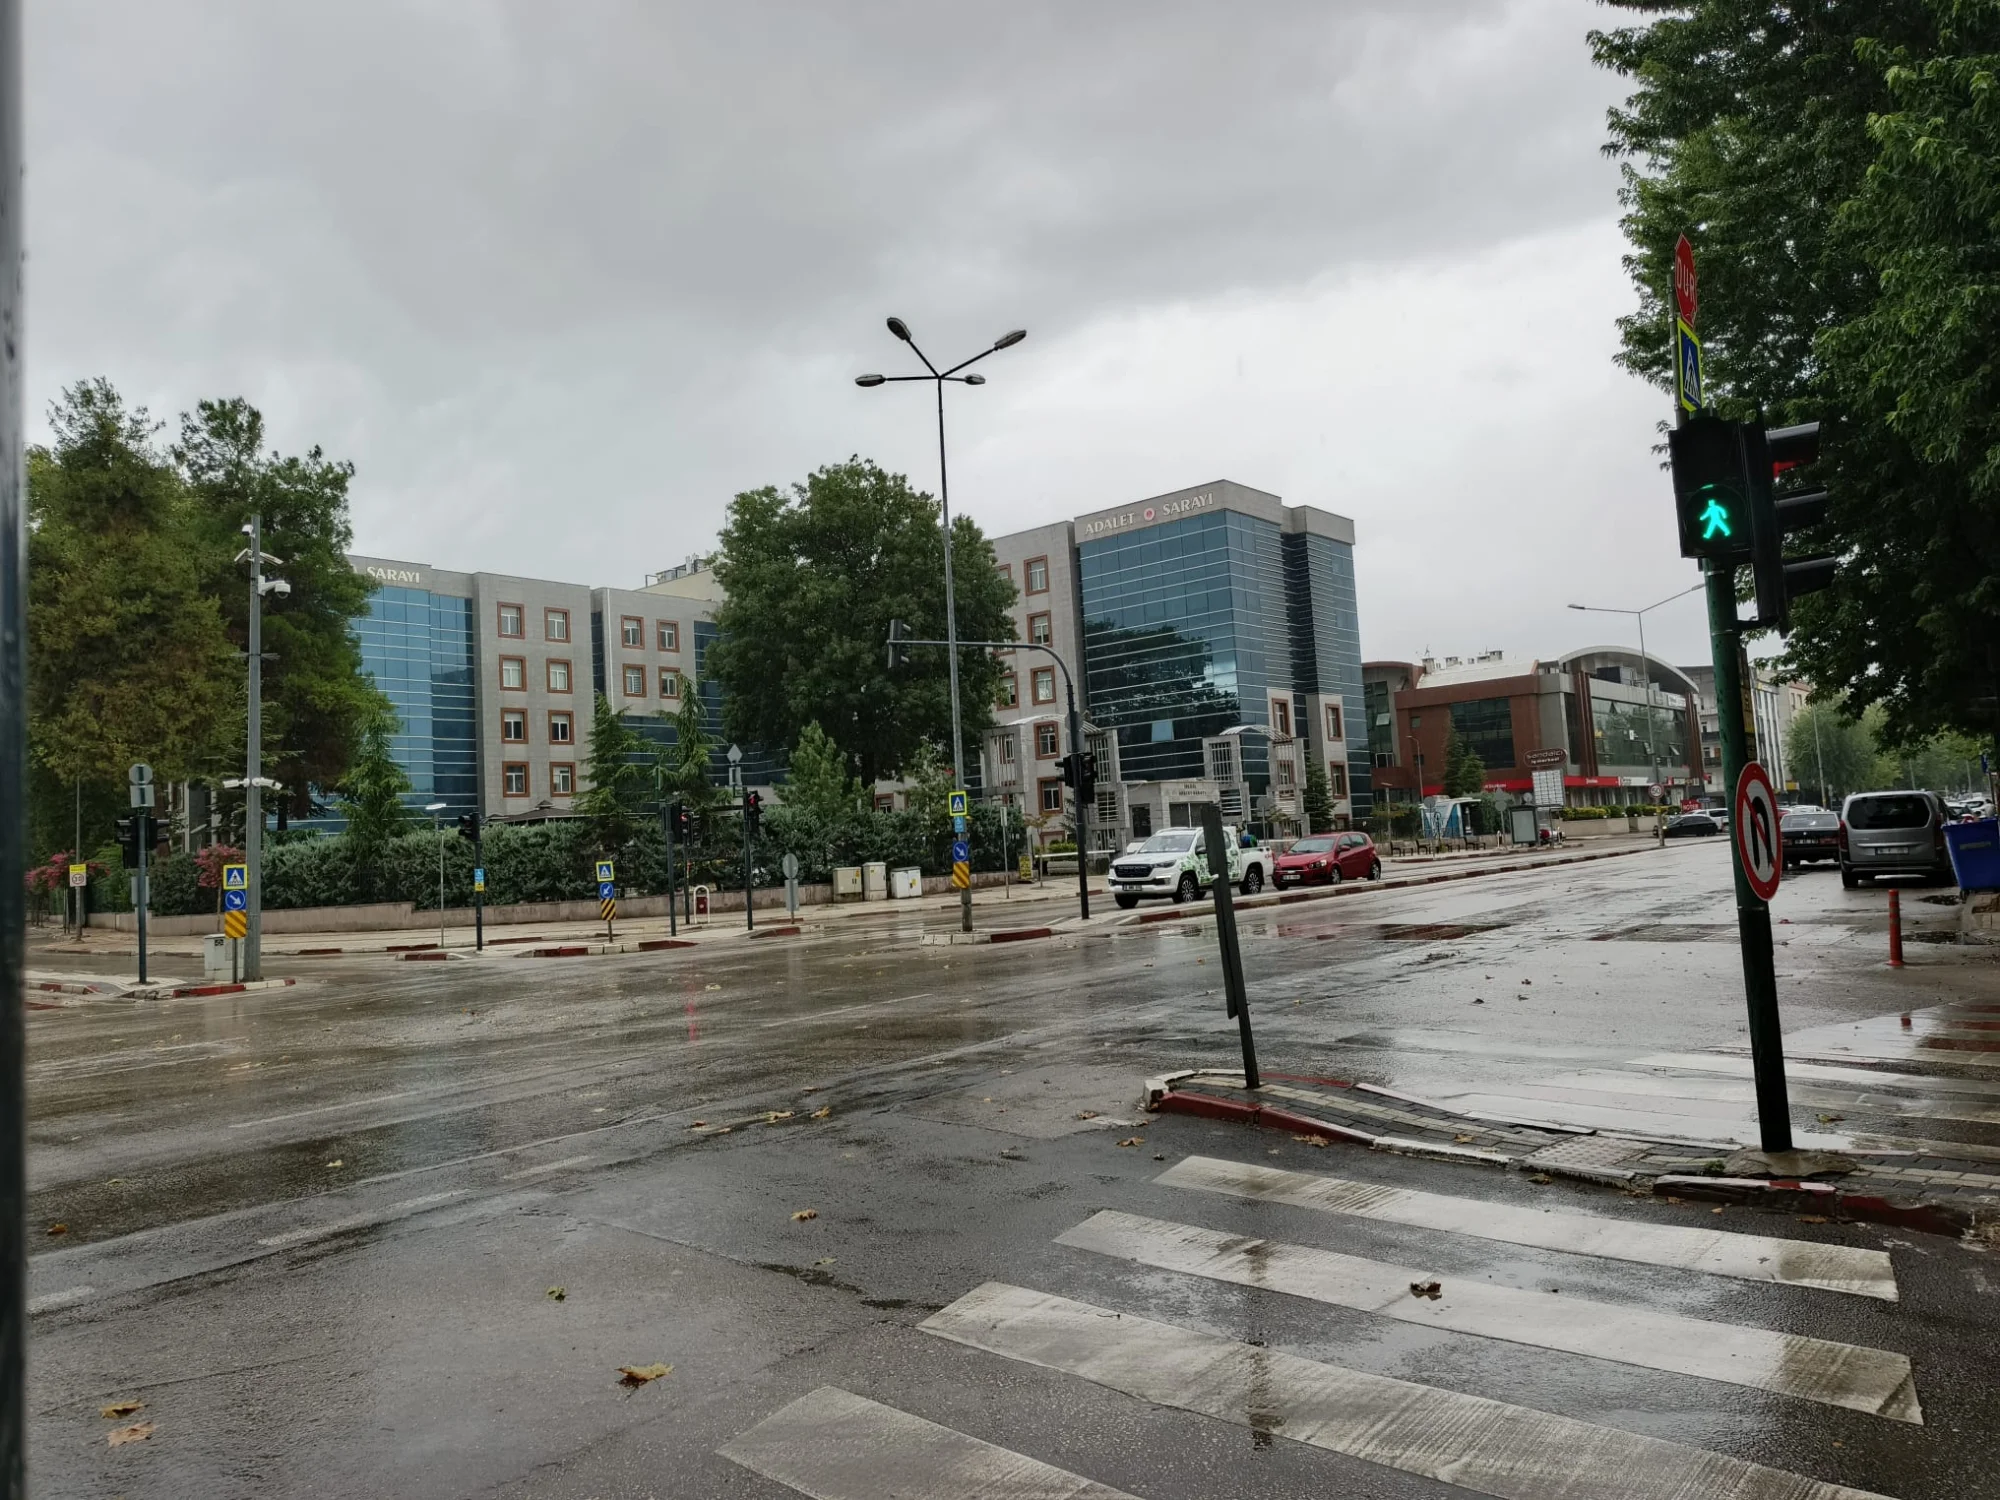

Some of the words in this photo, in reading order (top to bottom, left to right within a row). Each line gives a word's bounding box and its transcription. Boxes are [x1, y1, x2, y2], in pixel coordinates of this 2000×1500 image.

[1676, 255, 1696, 307] DUR
[1085, 512, 1135, 535] ADALET
[1162, 492, 1213, 516] SARAYI
[366, 566, 420, 584] SARAYI
[1651, 787, 1661, 795] 50
